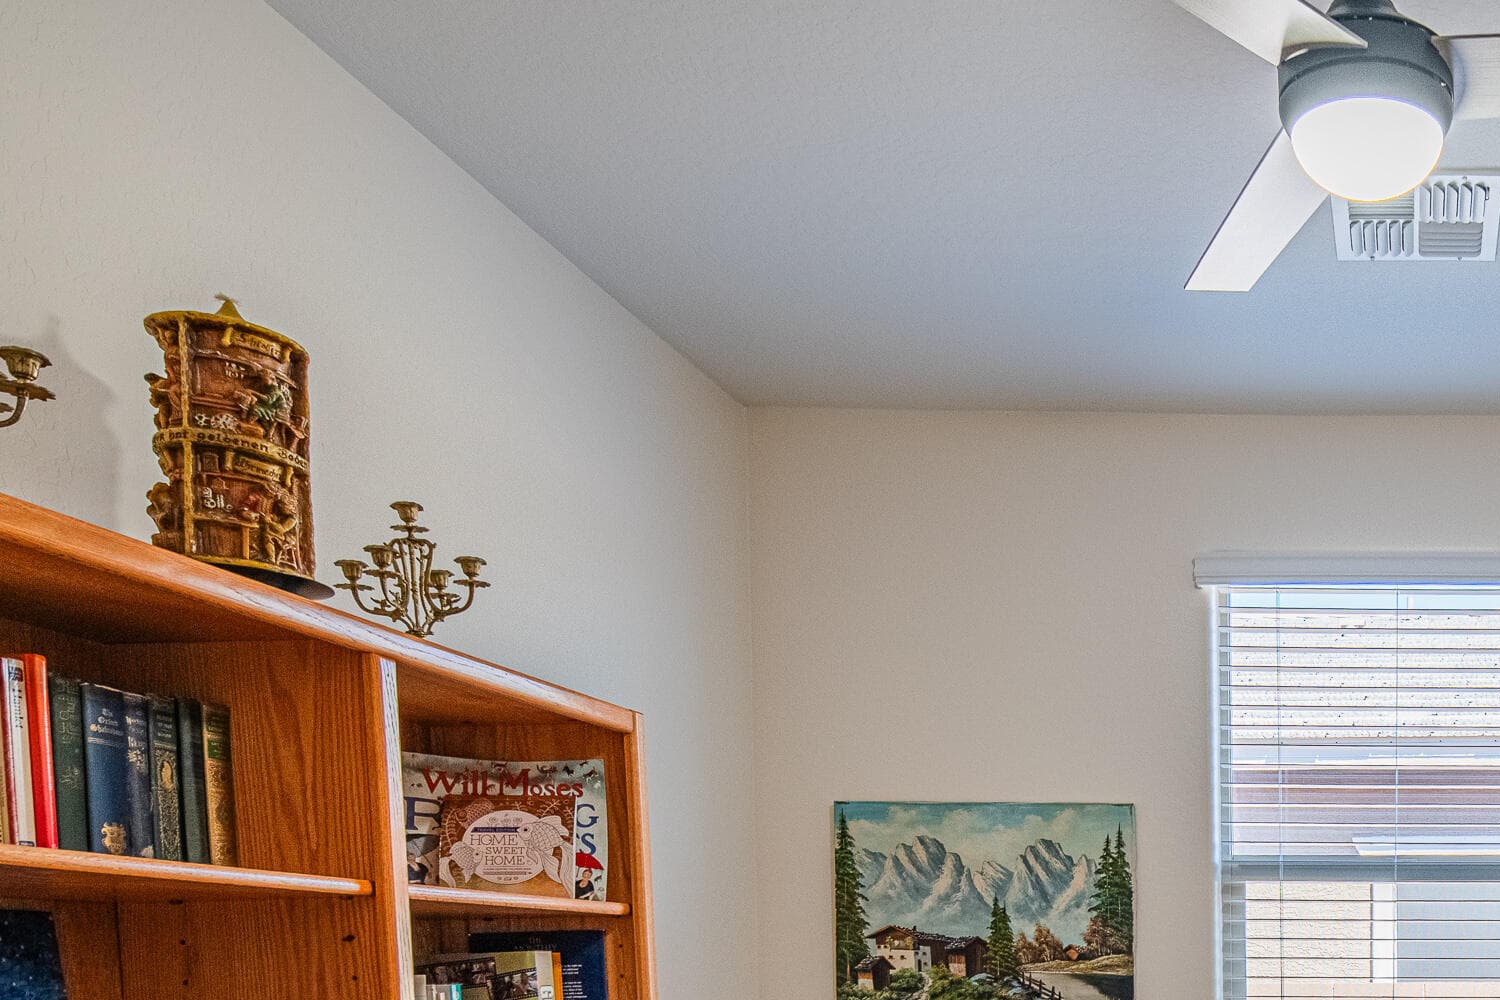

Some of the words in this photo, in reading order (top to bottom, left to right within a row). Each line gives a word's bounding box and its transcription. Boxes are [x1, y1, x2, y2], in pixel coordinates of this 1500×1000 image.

[423, 768, 488, 798] Will
[501, 768, 584, 798] Moses
[470, 834, 518, 846] HOME
[485, 846, 525, 855] SWEET
[485, 856, 526, 866] HOME
